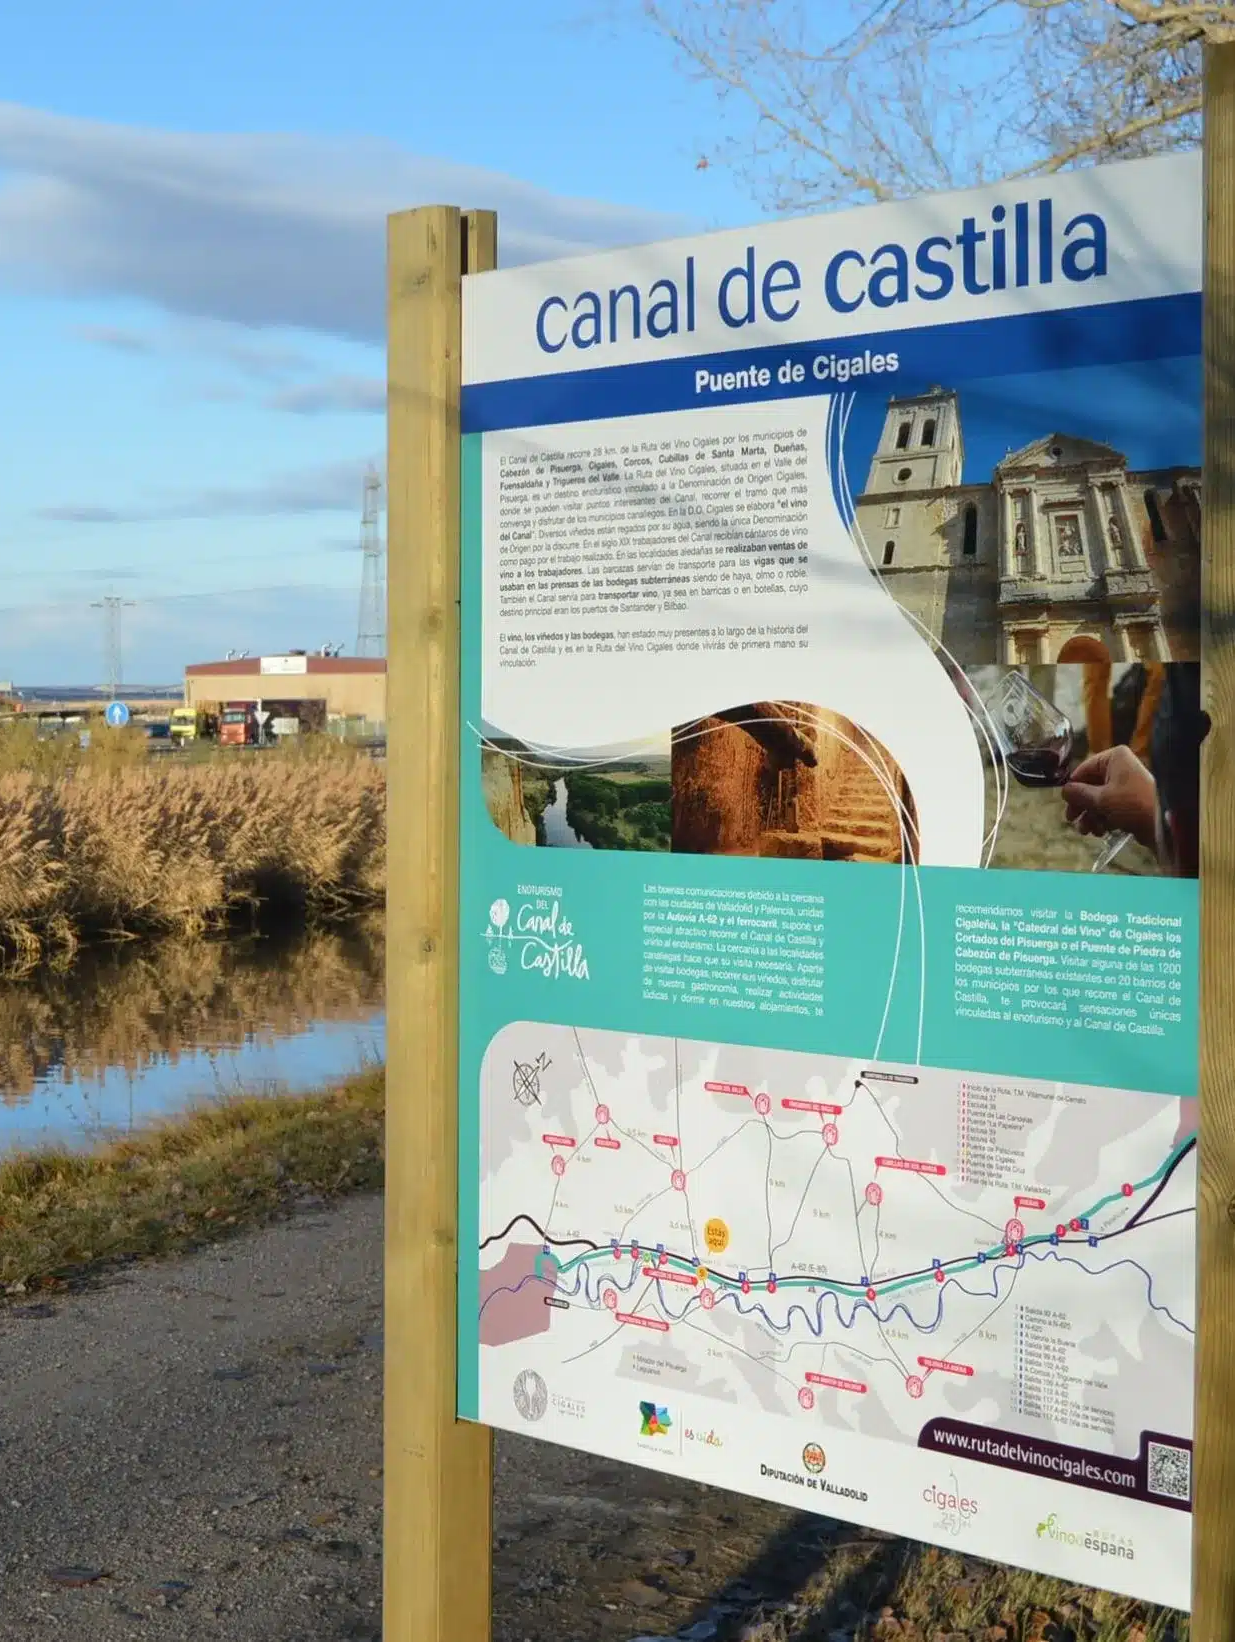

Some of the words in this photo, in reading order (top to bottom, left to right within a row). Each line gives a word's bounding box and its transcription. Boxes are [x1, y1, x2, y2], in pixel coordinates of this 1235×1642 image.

[536, 256, 696, 354] canal
[718, 245, 801, 326] de
[825, 198, 1109, 314] castilla
[695, 366, 771, 394] Puente
[777, 359, 806, 385] de
[812, 349, 899, 385] Cigales
[499, 467, 529, 478] Cabezón
[535, 466, 544, 475] de
[550, 462, 582, 476] Pisuerga,
[588, 459, 617, 473] Cigales,
[623, 456, 652, 468] Corcos,
[658, 452, 689, 464] Cubillas
[695, 451, 705, 461] de
[711, 448, 734, 460] Santa
[741, 445, 766, 458] Marta,
[773, 441, 806, 455] Dueñas,
[517, 884, 563, 897] ENOTURISMO
[536, 899, 549, 909] DEL
[517, 900, 559, 938] Canal
[558, 916, 575, 936] de
[955, 902, 1023, 917] recomendamos
[1030, 907, 1056, 919] visitar
[1064, 909, 1072, 920] la
[1080, 910, 1118, 925] Bodega
[1127, 912, 1181, 927] Tradicional
[955, 917, 997, 933] Cigaleña,
[1001, 920, 1010, 931] la
[1013, 921, 1058, 934] "Catedral
[1061, 924, 1076, 936] del
[1079, 925, 1105, 938] Vino"
[1109, 927, 1121, 939] de
[1125, 928, 1163, 944] Cigales
[1166, 930, 1181, 942] los
[955, 932, 998, 946] Cortados
[1000, 935, 1014, 947] del
[1017, 936, 1058, 952] Pisuerga
[1061, 941, 1067, 950] o
[1070, 940, 1078, 951] el
[1081, 941, 1116, 954] Puente
[1118, 943, 1130, 955] de
[1133, 944, 1166, 957] Piedra
[1168, 946, 1181, 958] de
[521, 940, 590, 981] Castilla
[955, 947, 996, 960] Cabezón
[998, 950, 1010, 962] de
[1013, 951, 1057, 967] Pisuerga.
[1060, 954, 1087, 967] Visitar
[1091, 957, 1122, 972] alguna
[1125, 959, 1137, 971] de
[1140, 960, 1153, 972] las
[1158, 962, 1181, 974] 1200
[955, 962, 992, 978] bodegas
[995, 965, 1053, 980] subterráneas
[1055, 969, 1102, 984] existentes
[1104, 975, 1116, 985] en
[1118, 974, 1131, 986] 20
[1132, 975, 1166, 989] barrios
[1168, 978, 1181, 990] de
[954, 977, 967, 988] los
[971, 978, 1019, 995] municipios
[1024, 984, 1039, 996] por
[1044, 984, 1057, 996] los
[1062, 987, 1080, 1000] que
[1084, 989, 1117, 1000] recorre
[1122, 990, 1130, 1002] el
[1135, 991, 1163, 1004] Canal
[1168, 994, 1181, 1006] de
[954, 991, 988, 1006] Castilla,
[1000, 995, 1010, 1007] te
[1021, 997, 1066, 1014] provocará
[1079, 1002, 1137, 1018] sensaciones
[1149, 1008, 1181, 1022] únicas
[955, 1006, 1001, 1021] vinculadas
[1003, 1011, 1011, 1022] al
[1013, 1011, 1064, 1027] enoturismo
[1066, 1018, 1071, 1030] y
[1073, 1017, 1081, 1028] al
[1084, 1018, 1111, 1031] Canal
[1113, 1020, 1126, 1032] de
[1128, 1022, 1164, 1036] Castilla.
[933, 1427, 1137, 1489] www.rutadelvinocigales.com
[923, 1484, 978, 1518] cigales
